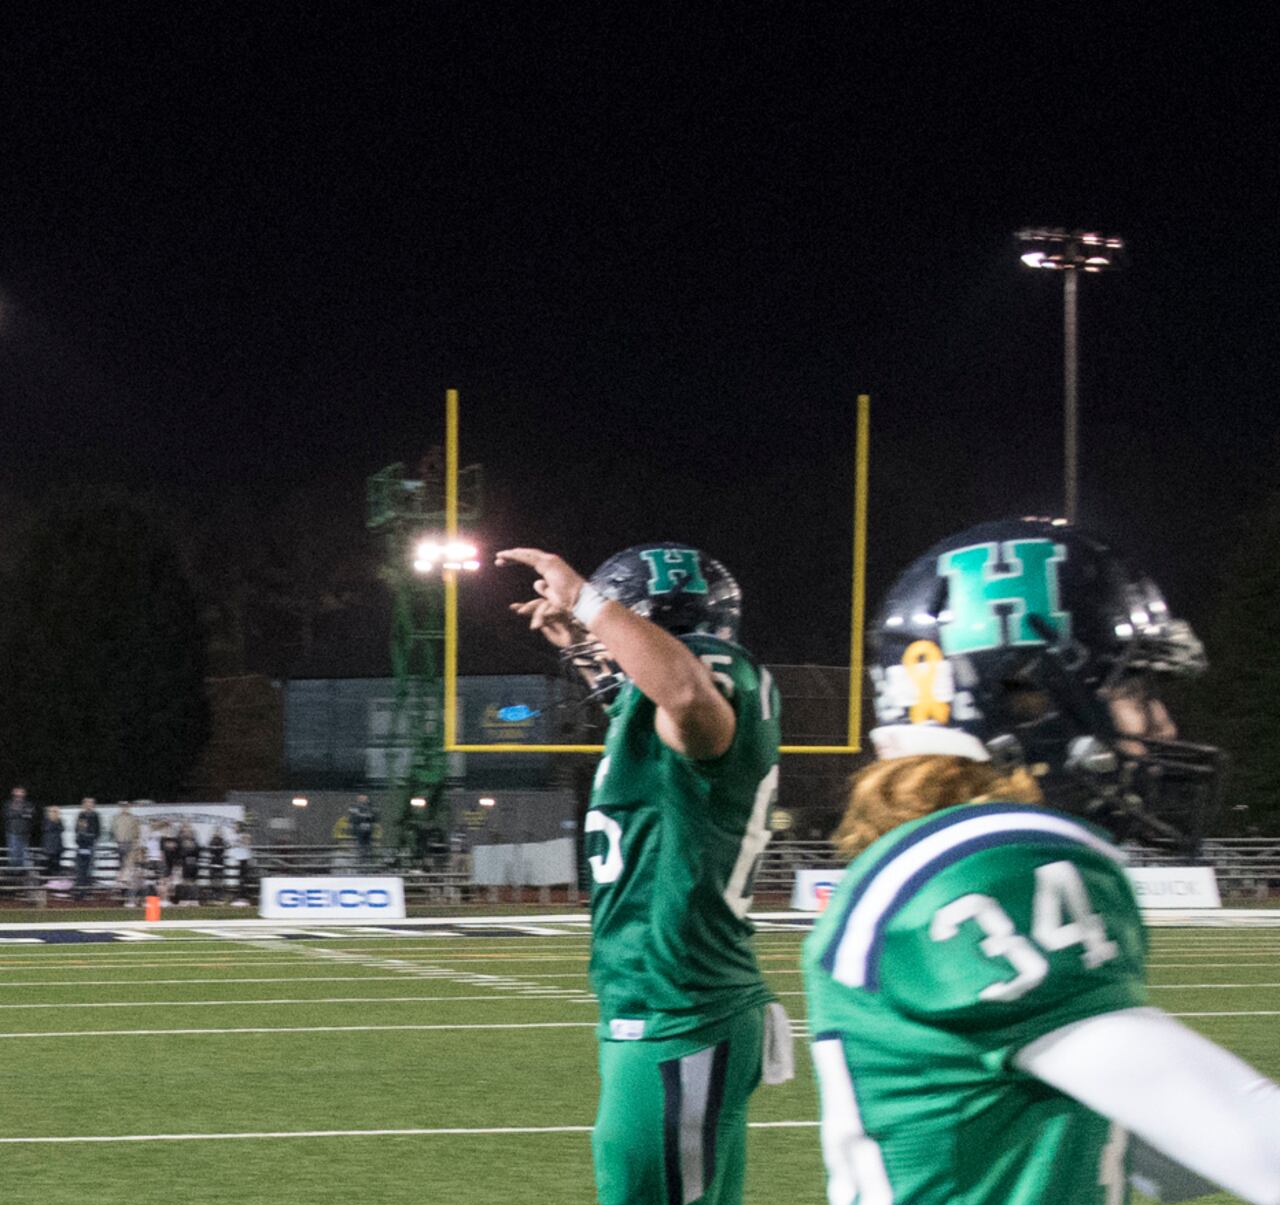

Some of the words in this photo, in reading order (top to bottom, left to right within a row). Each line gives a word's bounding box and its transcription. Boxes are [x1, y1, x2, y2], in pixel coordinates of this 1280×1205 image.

[641, 549, 708, 595] H
[937, 539, 1071, 656] H
[278, 889, 391, 909] GEICO
[929, 860, 1120, 1001] 34
